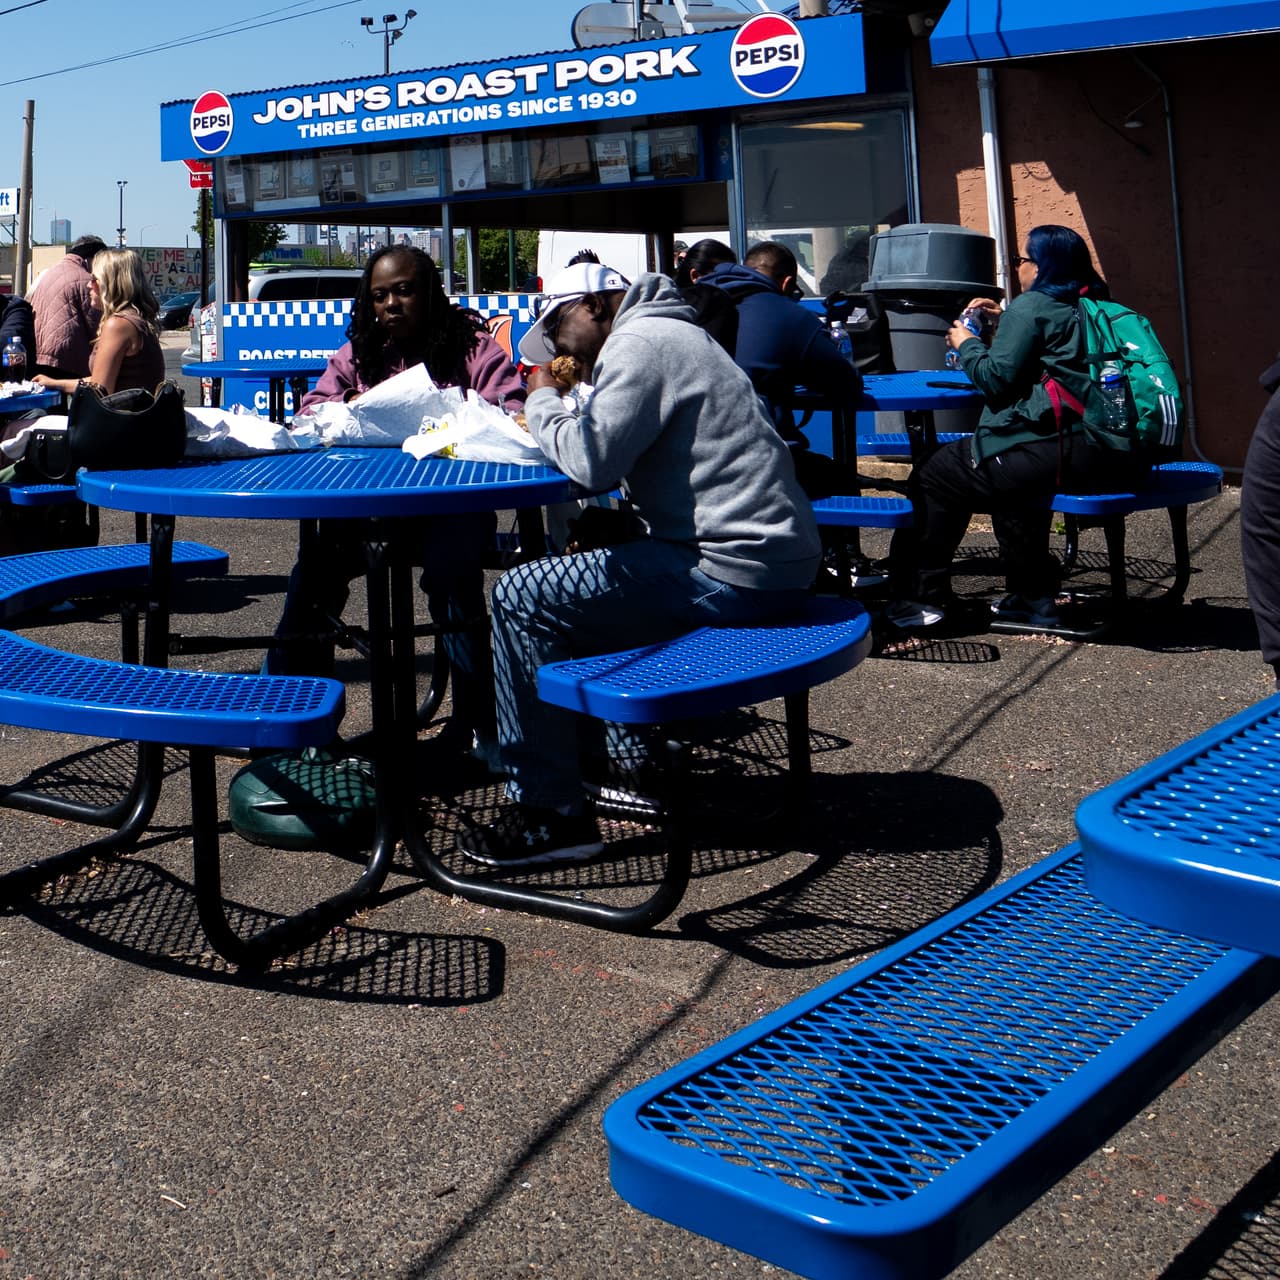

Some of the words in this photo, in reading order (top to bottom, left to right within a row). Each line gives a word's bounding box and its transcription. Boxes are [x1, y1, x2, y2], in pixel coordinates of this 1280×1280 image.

[735, 43, 800, 67] PEPSI
[253, 85, 391, 124] JOHN'S
[397, 64, 548, 107] ROAST
[555, 45, 700, 90] PORK
[193, 113, 231, 131] PEPSI
[297, 122, 357, 139] THREE
[361, 104, 502, 132] GENERATIONS
[507, 96, 573, 117] SINCE
[578, 89, 637, 110] 1930
